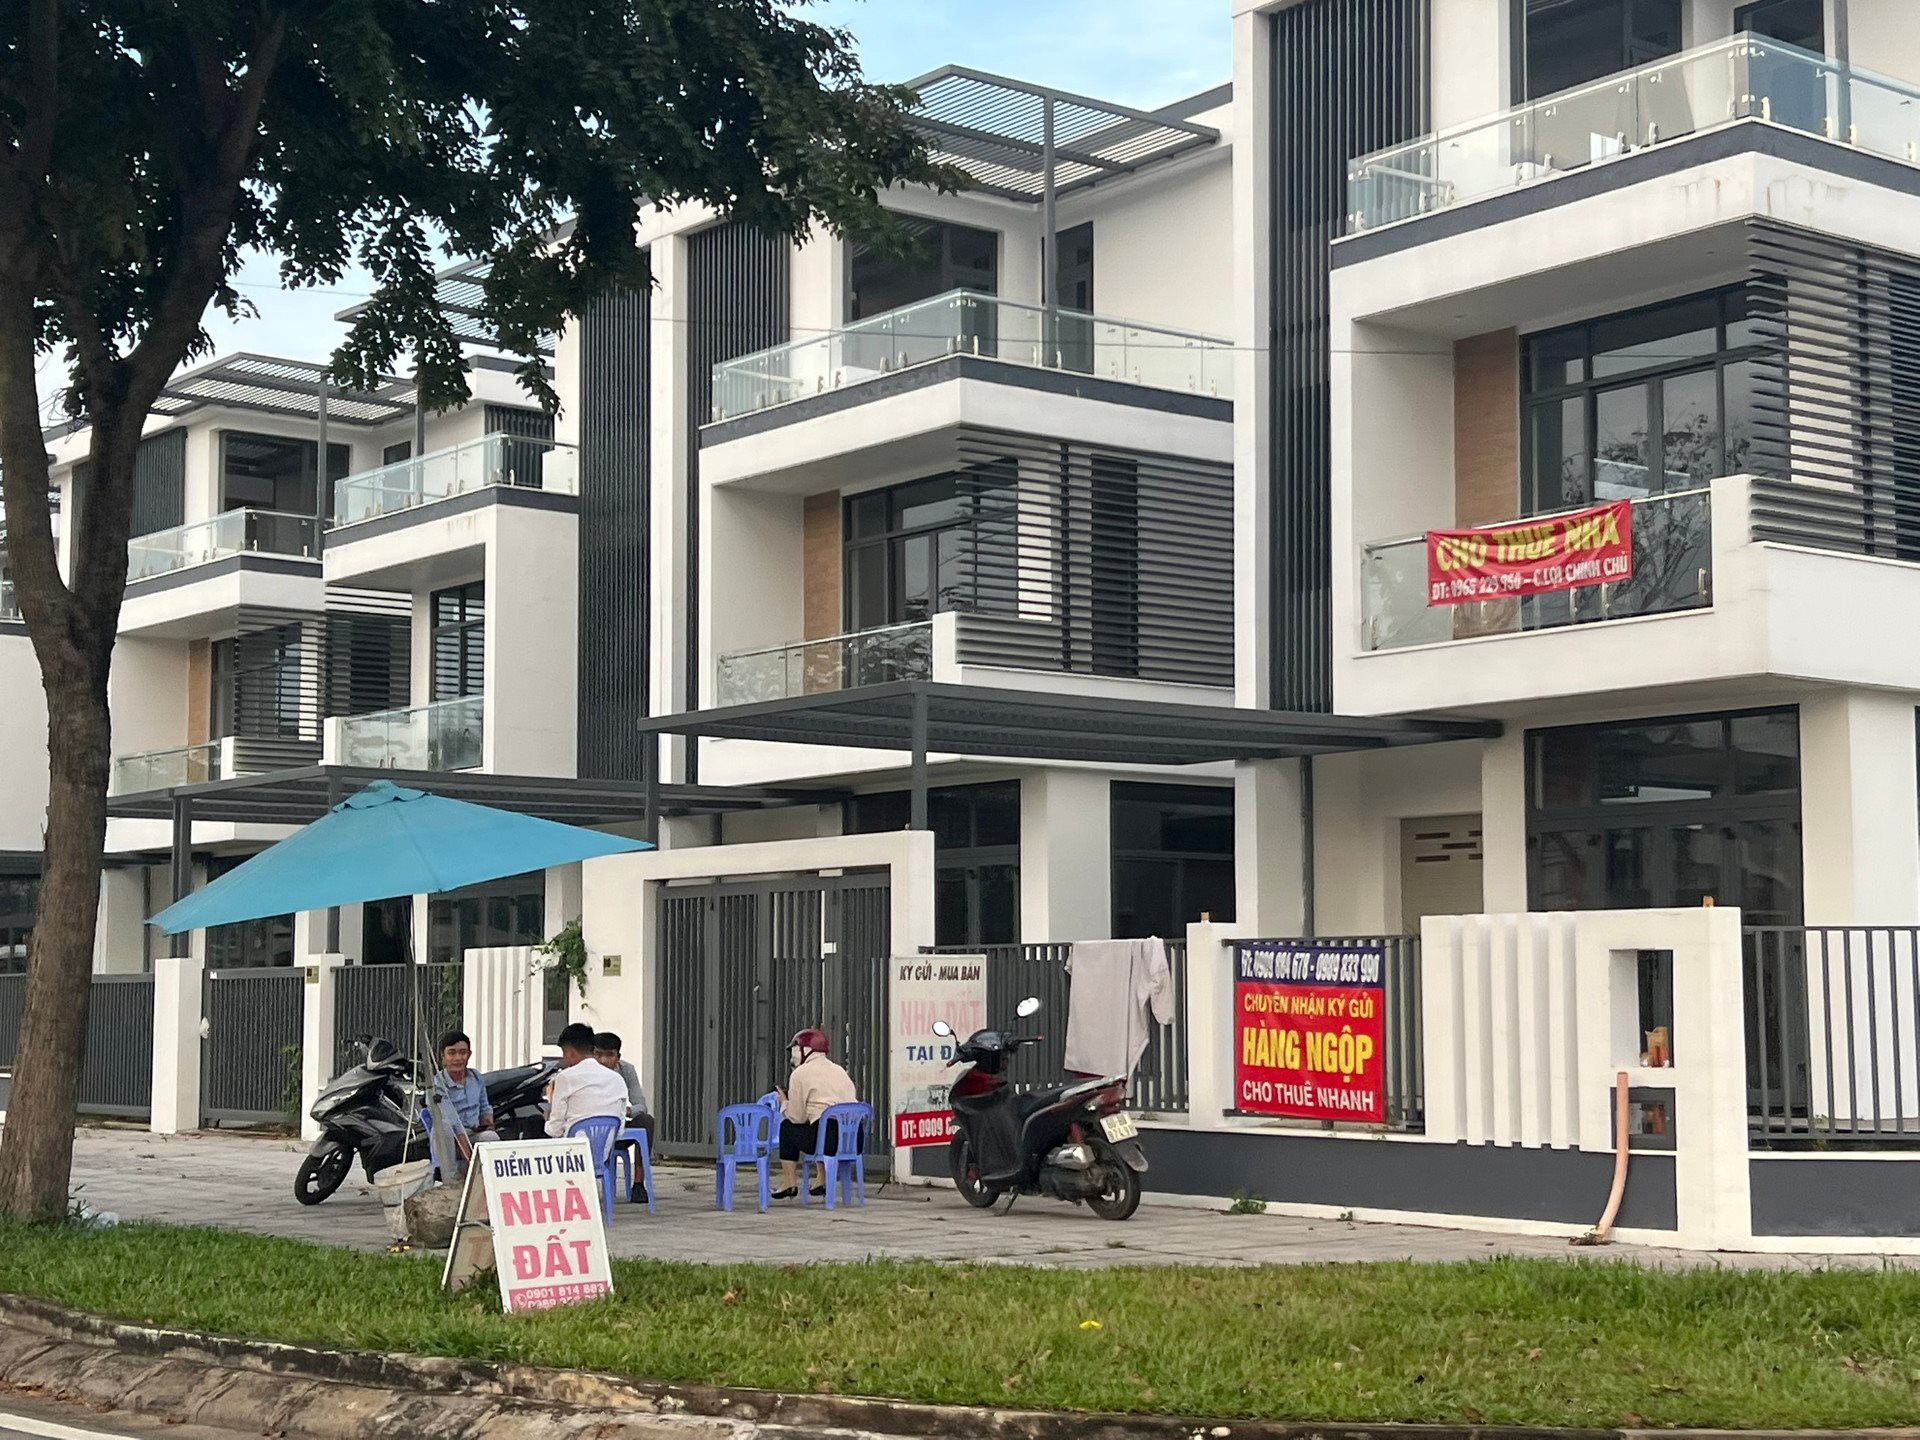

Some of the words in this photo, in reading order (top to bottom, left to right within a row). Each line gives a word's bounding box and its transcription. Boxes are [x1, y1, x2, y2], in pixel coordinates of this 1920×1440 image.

[1436, 534, 1488, 571] CHO
[1603, 550, 1628, 576] CHỦ
[938, 965, 959, 980] MUA
[1244, 990, 1288, 1013] CHUYÊN
[1291, 992, 1324, 1019] NHẬN
[1328, 993, 1345, 1017] KÝ
[1349, 991, 1374, 1018] GỬI
[1242, 1019, 1300, 1070] HÀNG
[1305, 1025, 1373, 1083] NGỘP
[1242, 1080, 1272, 1103] CHO
[1274, 1080, 1315, 1107] THUÊ
[1317, 1086, 1374, 1112] NHANH
[494, 1150, 532, 1178] ĐIỂM
[534, 1154, 554, 1175] TƯ
[555, 1148, 586, 1173] VẤN
[500, 1180, 591, 1226] NHÀ
[512, 1229, 591, 1280] ĐẤT
[525, 1287, 555, 1300] 0901
[559, 1285, 580, 1297] 814
